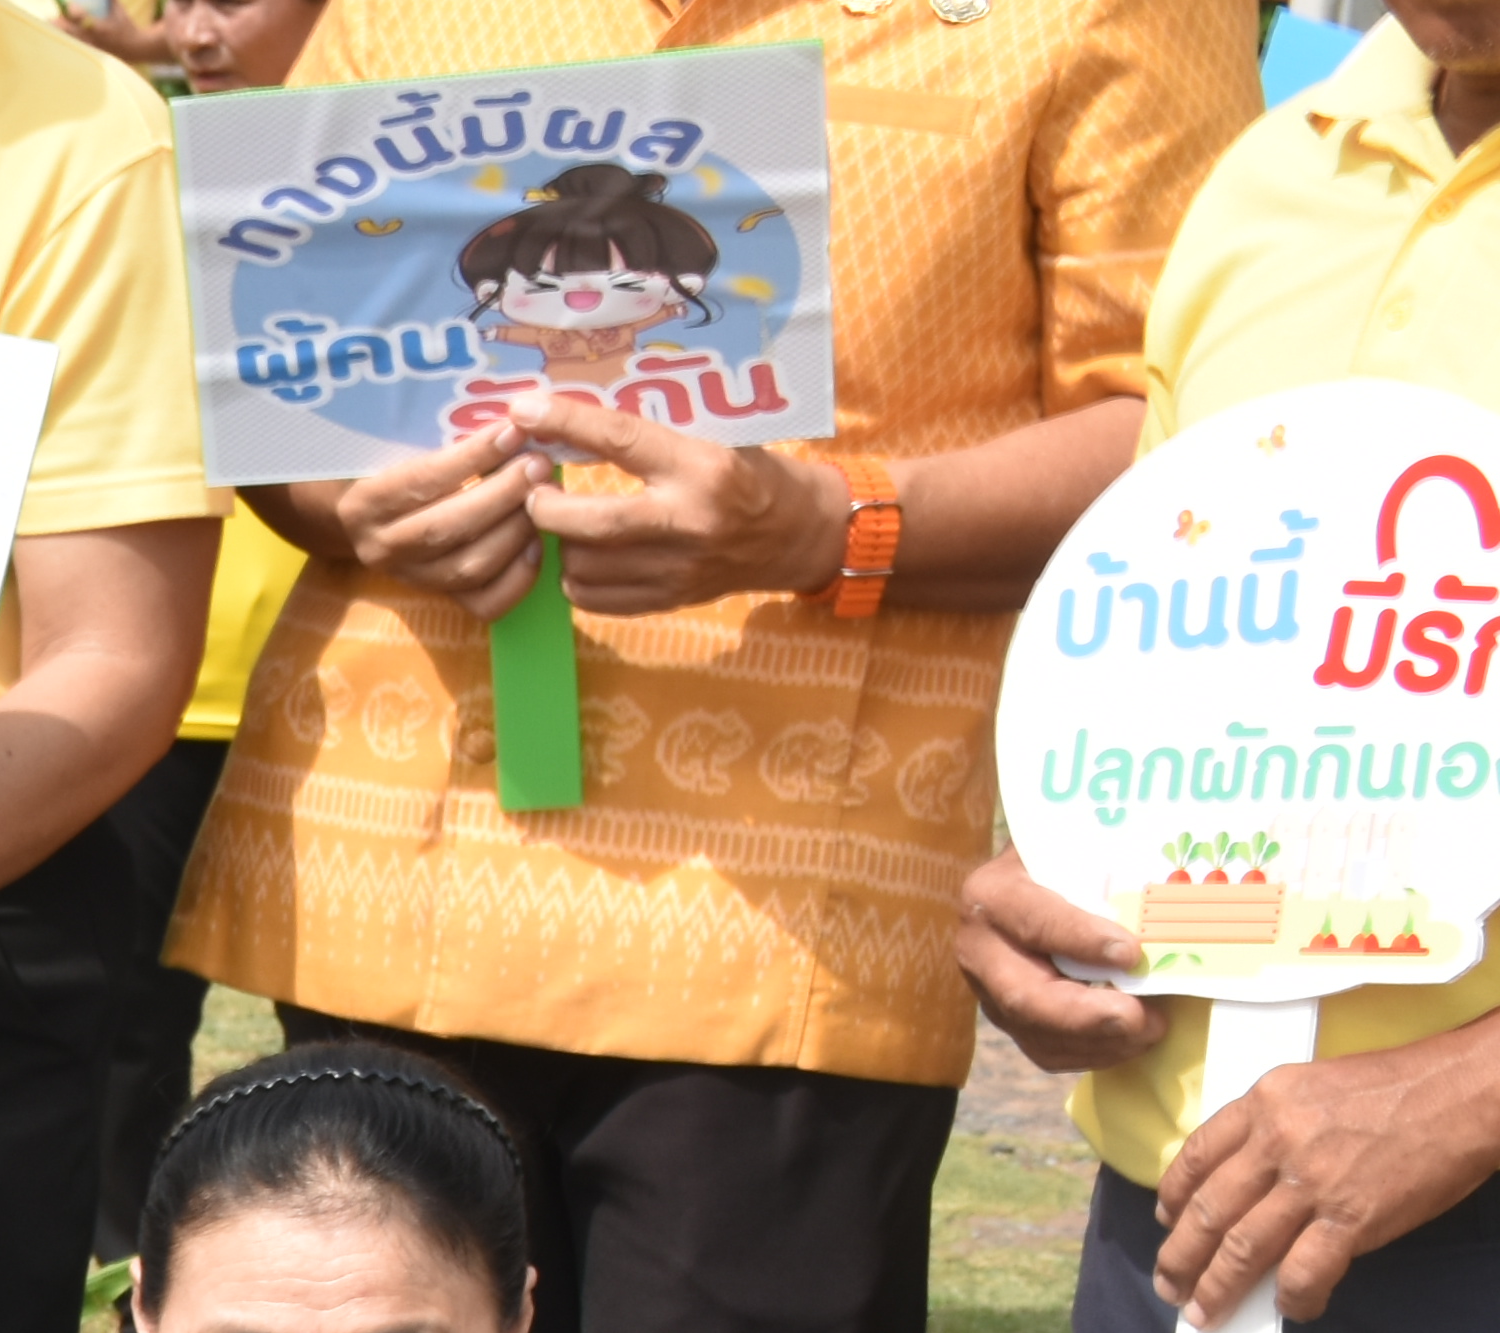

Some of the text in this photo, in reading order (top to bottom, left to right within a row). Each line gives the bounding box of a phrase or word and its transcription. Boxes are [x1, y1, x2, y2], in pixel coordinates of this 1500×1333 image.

[217, 91, 704, 261] ทางนี้มีผล
[235, 318, 477, 402] ผู้คน
[450, 356, 789, 444] รักัน
[1055, 509, 1319, 658] บ้านนี้
[1040, 721, 1500, 827] ปลูกผักกินเอ
